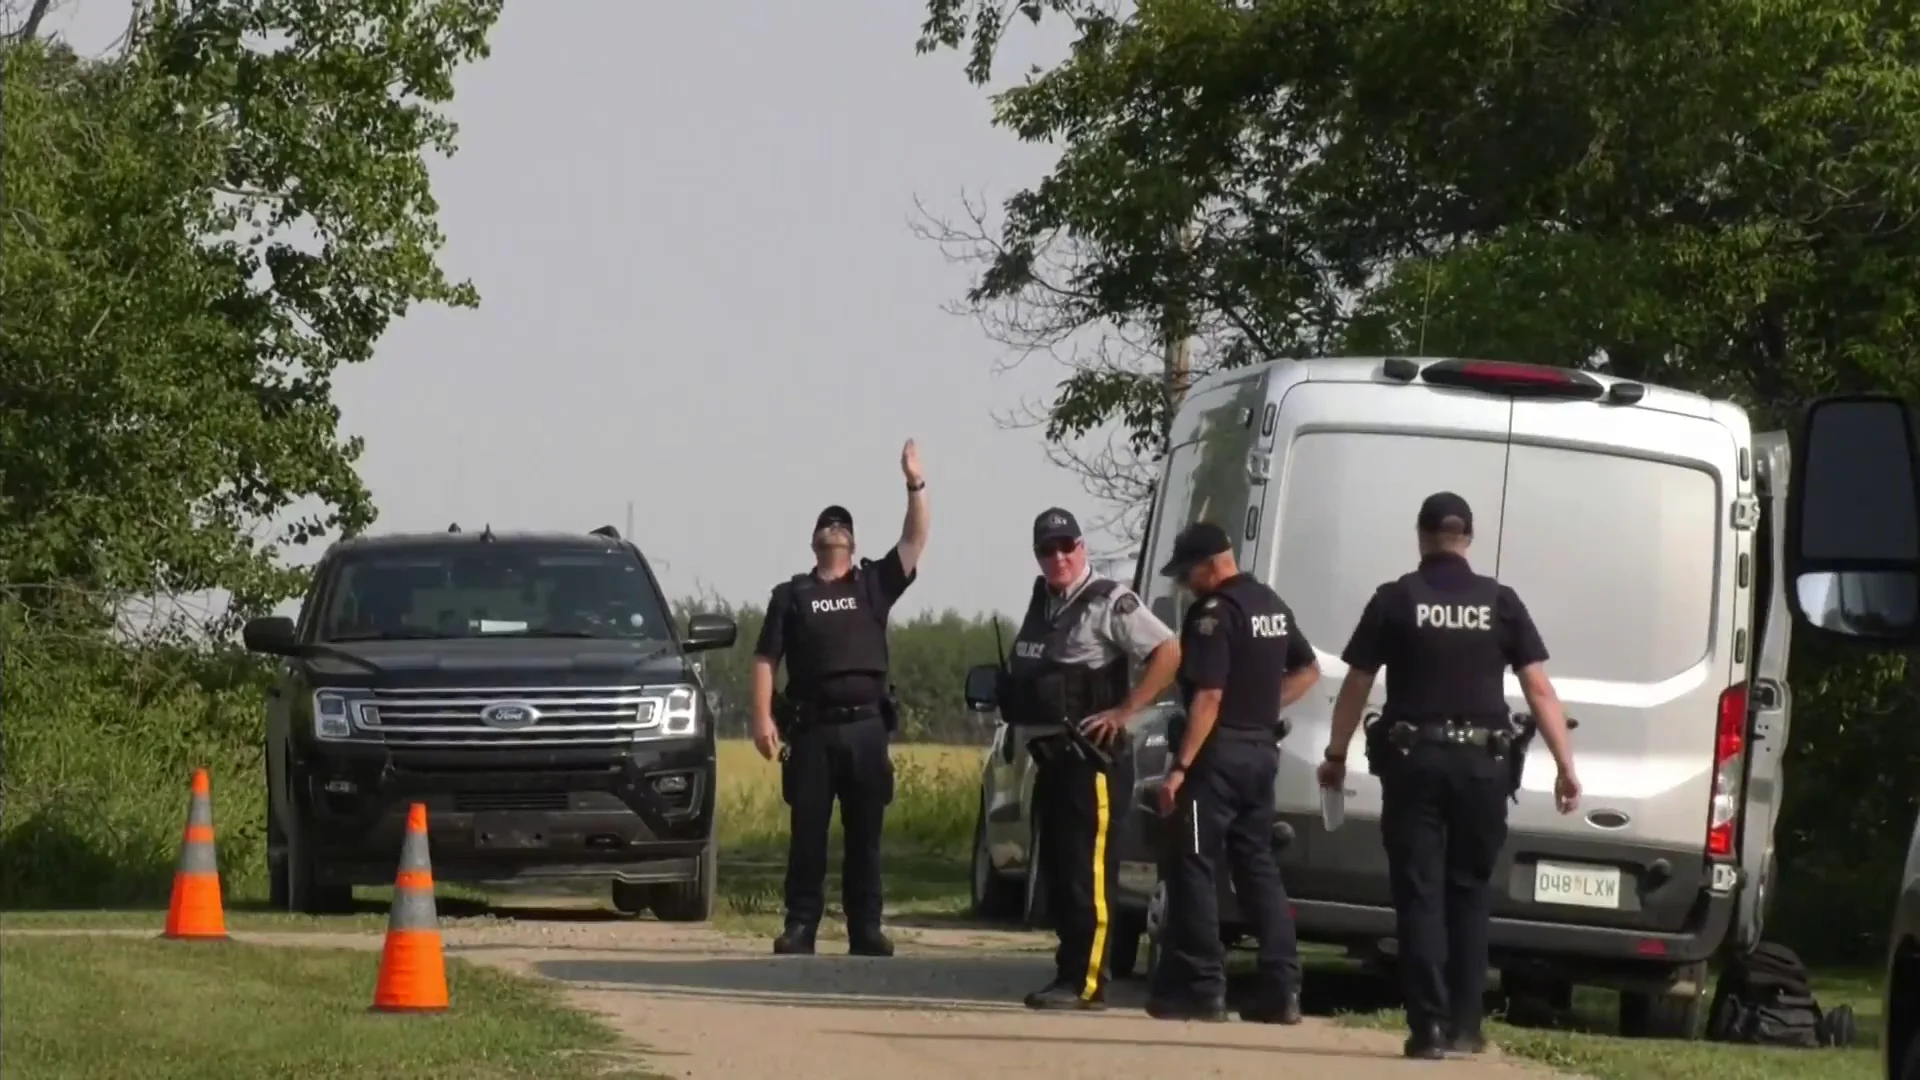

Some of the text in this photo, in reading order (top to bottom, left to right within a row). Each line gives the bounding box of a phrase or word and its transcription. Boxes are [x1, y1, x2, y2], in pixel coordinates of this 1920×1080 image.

[811, 597, 858, 613] POLICE
[1416, 603, 1491, 630] POLICE
[1251, 613, 1288, 637] POLICE
[495, 709, 524, 720] Ford
[1540, 873, 1616, 897] 048 LXW
